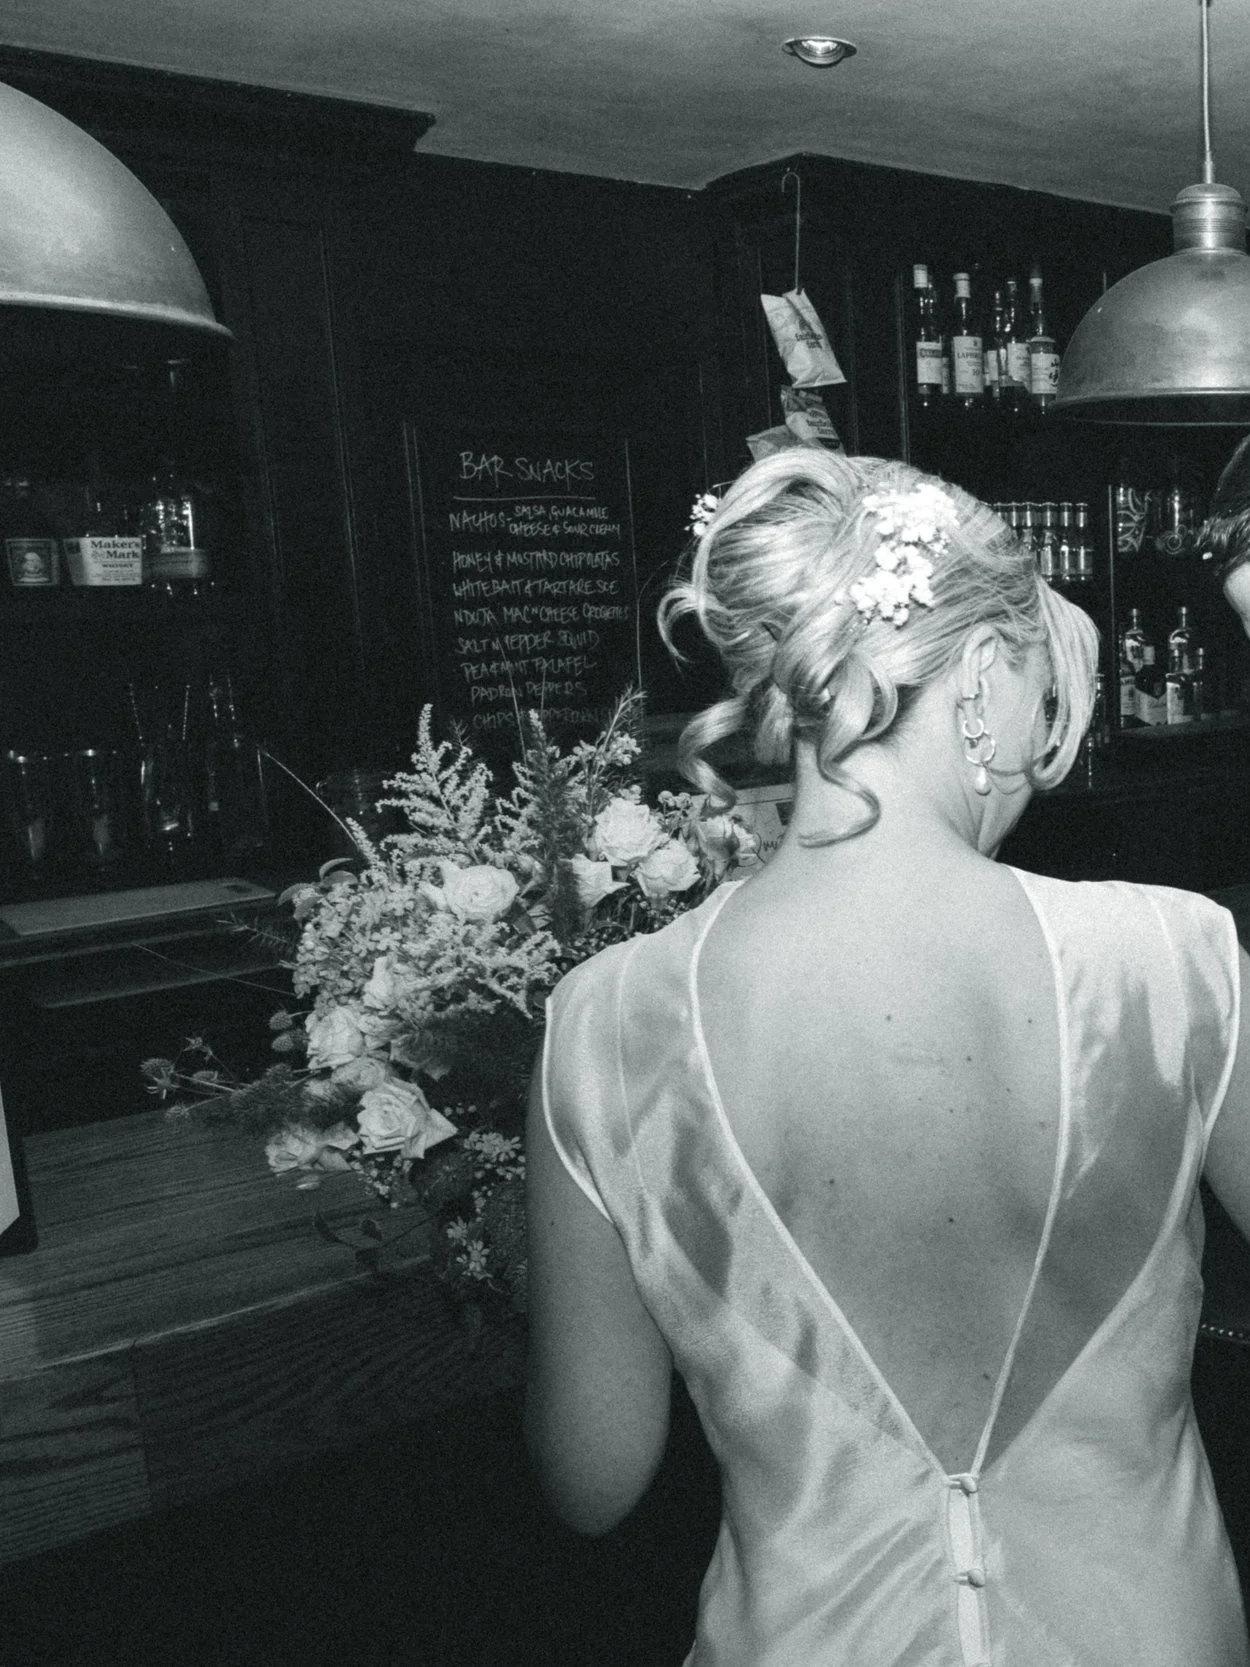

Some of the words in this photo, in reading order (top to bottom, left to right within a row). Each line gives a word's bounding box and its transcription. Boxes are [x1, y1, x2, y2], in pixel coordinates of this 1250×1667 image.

[459, 451, 513, 489] BAR
[514, 457, 594, 491] SNACKS
[449, 510, 505, 533] NACHOS
[509, 521, 551, 538] CHEESE
[562, 521, 590, 538] SOUR
[90, 540, 141, 549] Maker's
[106, 550, 141, 559] Mark
[451, 551, 493, 575] HONEY
[494, 550, 504, 571] &
[506, 549, 557, 572] MUSTARD
[452, 580, 524, 601] WHITEBAIT
[531, 578, 596, 599] TARTARE
[502, 604, 532, 625] MAC
[538, 605, 579, 625] CHEESE
[454, 637, 489, 655] SALT
[556, 630, 600, 652] SQUID
[459, 662, 490, 685] PEA
[529, 656, 597, 678] FALAFEL
[469, 684, 523, 706] PADRON
[524, 681, 587, 698] PEPPERS
